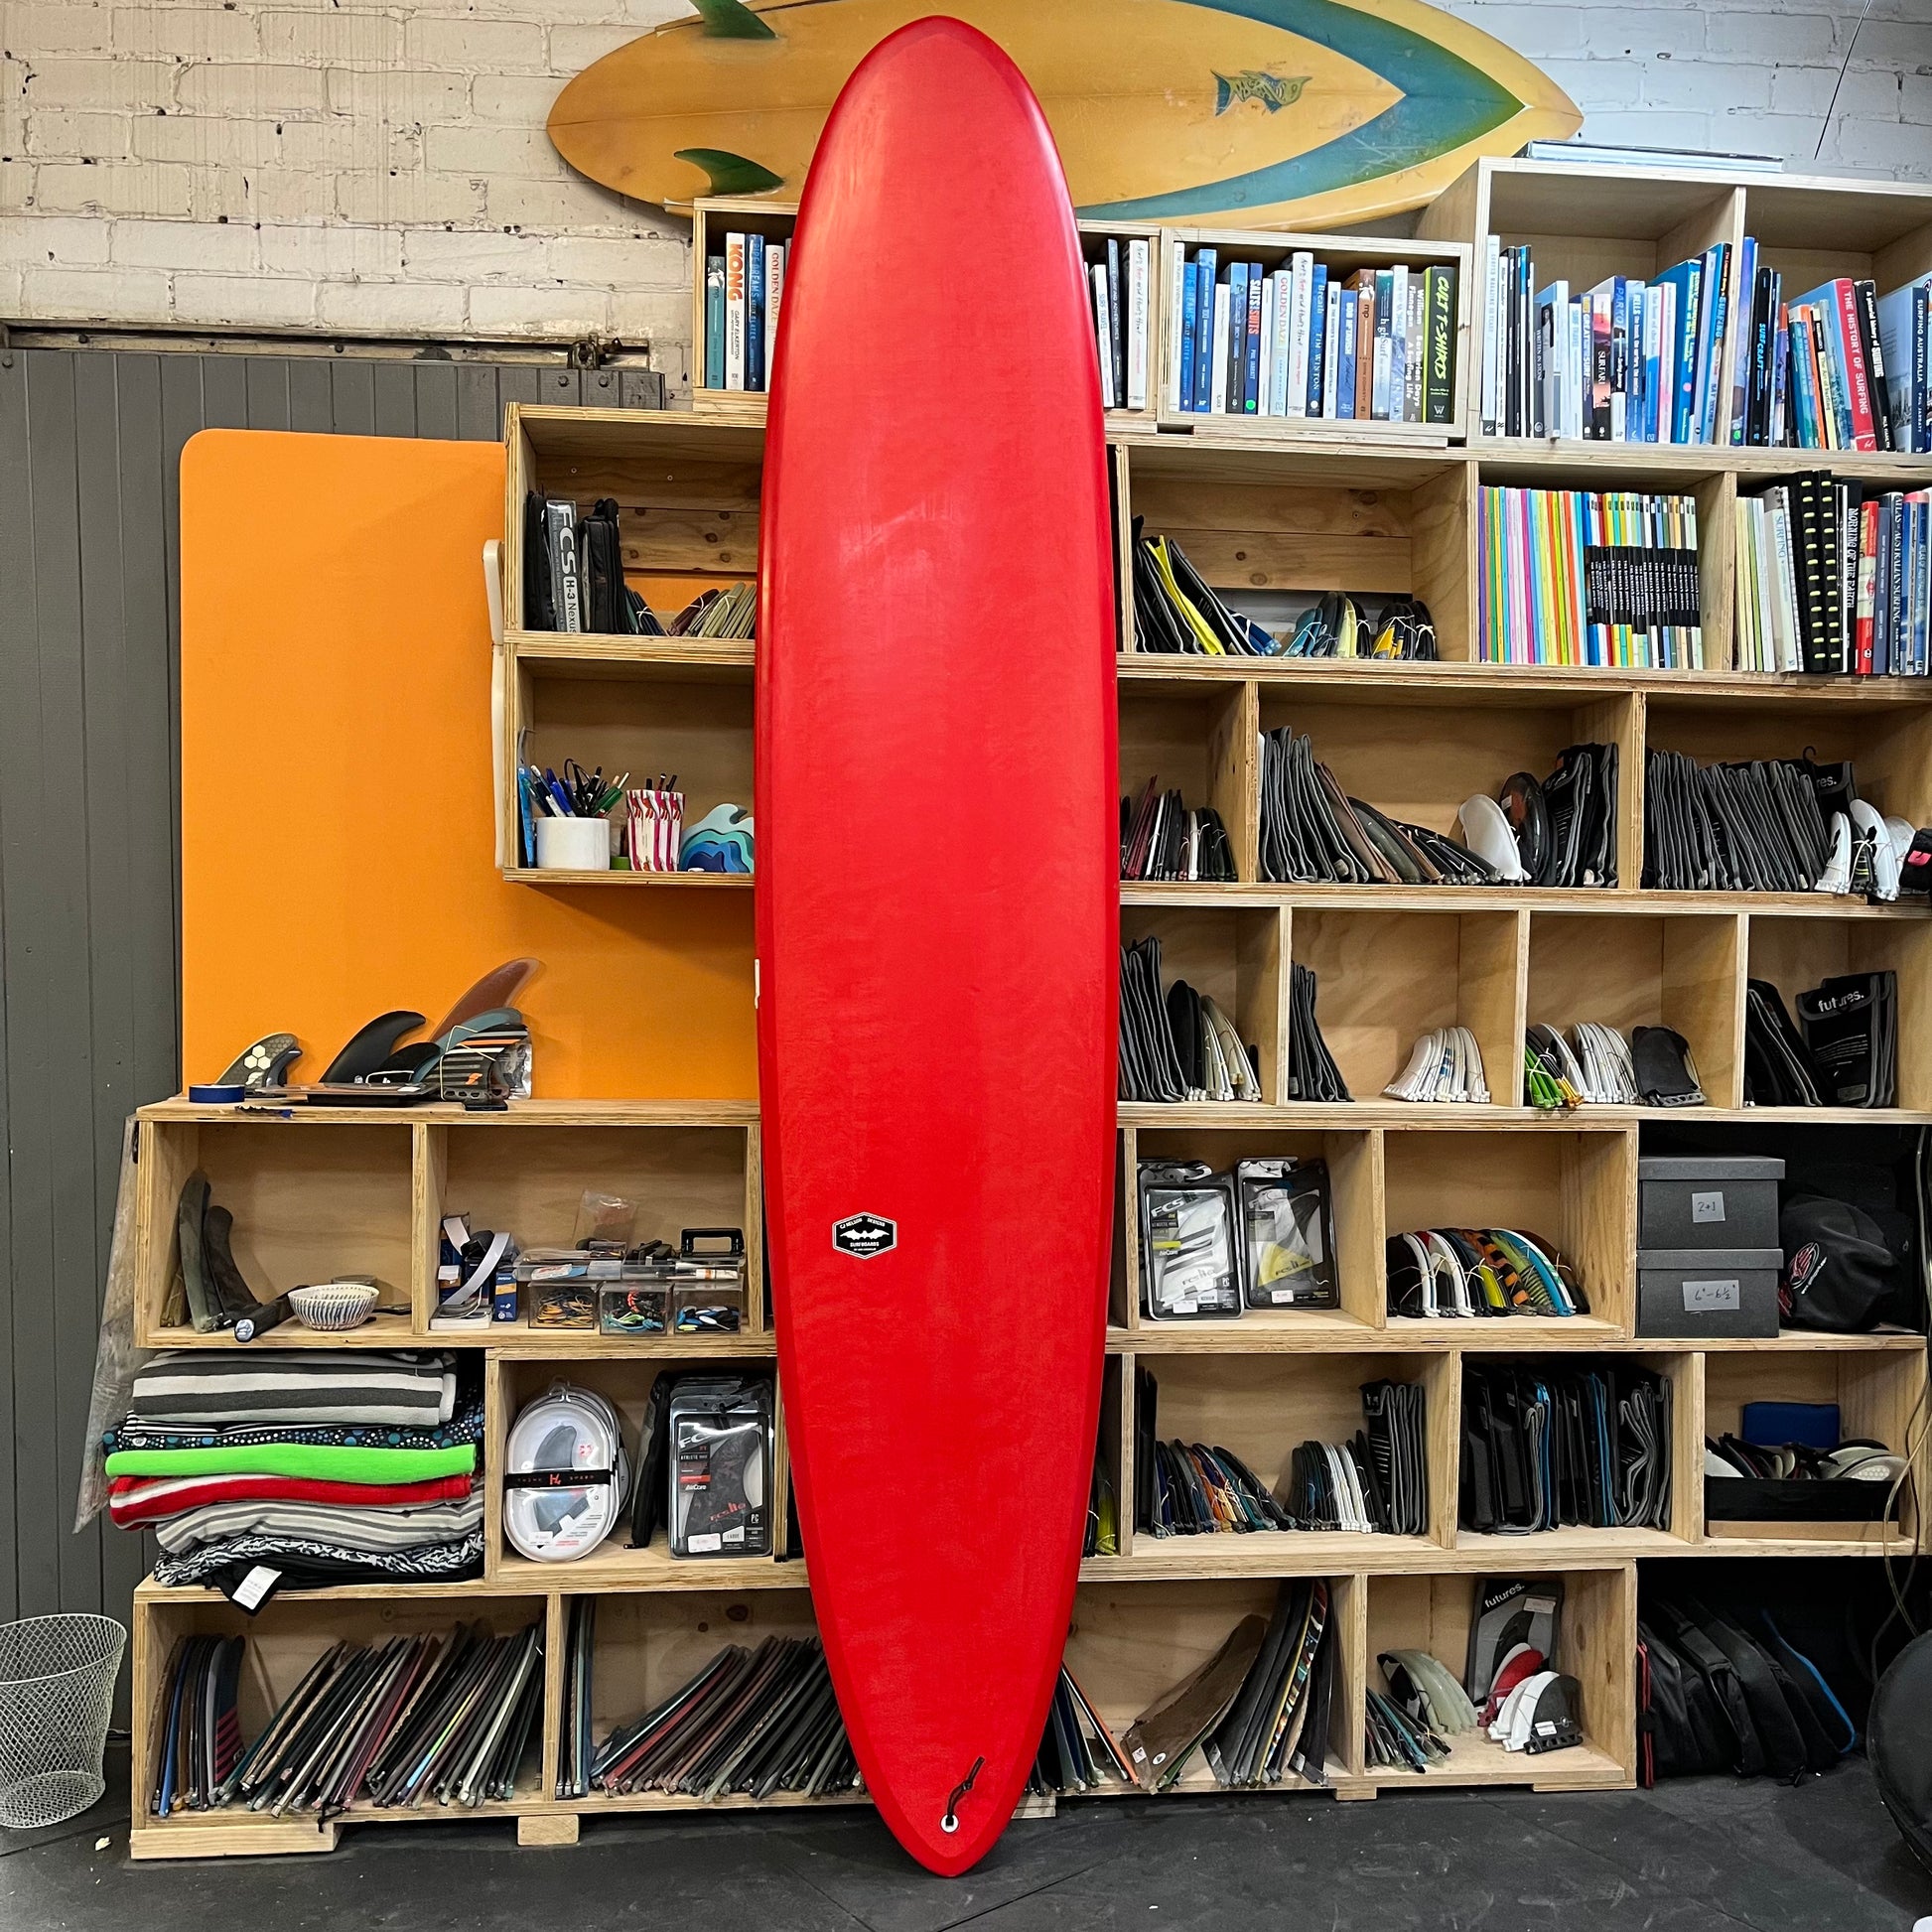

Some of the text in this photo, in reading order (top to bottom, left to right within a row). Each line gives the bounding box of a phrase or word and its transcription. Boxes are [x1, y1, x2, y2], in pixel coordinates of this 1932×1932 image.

[728, 243, 744, 301] KONG
[751, 264, 760, 298] DREAMS
[770, 252, 779, 323] GOLDEN DAZE
[1185, 286, 1194, 320] DREAMS
[1249, 279, 1262, 306] SALTS
[1407, 286, 1416, 328] Finnegan
[1436, 276, 1449, 314] CULT
[1615, 287, 1625, 324] PARKO
[1632, 294, 1641, 315] BELLS
[1865, 298, 1876, 320] pictorial
[1248, 309, 1260, 334] SUITS
[1278, 277, 1288, 345] GOLDEN DAZE
[1363, 304, 1371, 318] mp
[1716, 296, 1726, 338] SURFING
[1378, 318, 1390, 358] hghSurf
[1434, 314, 1449, 379] T-SHIRTS
[1756, 323, 1767, 369] SURFCRAFT
[1868, 320, 1878, 340] history
[1844, 292, 1868, 414] THE HISTORY OF SURFING
[1871, 347, 1884, 378] SURFING
[559, 505, 577, 574] FCS
[1775, 515, 1787, 558] SURFING
[1847, 508, 1859, 547] MORNING
[1847, 549, 1857, 560] OF
[1847, 562, 1856, 578] THE
[1892, 496, 1903, 623] ATLAS AUSTRALIAN SURFING
[566, 580, 576, 601] H-3
[1817, 776, 1837, 786] res.
[1818, 991, 1864, 1013] futures.
[1152, 1197, 1184, 1217] FCS
[1697, 1201, 1716, 1212] 2+1
[751, 1513, 759, 1524] PC
[1485, 1583, 1525, 1608] futures.
